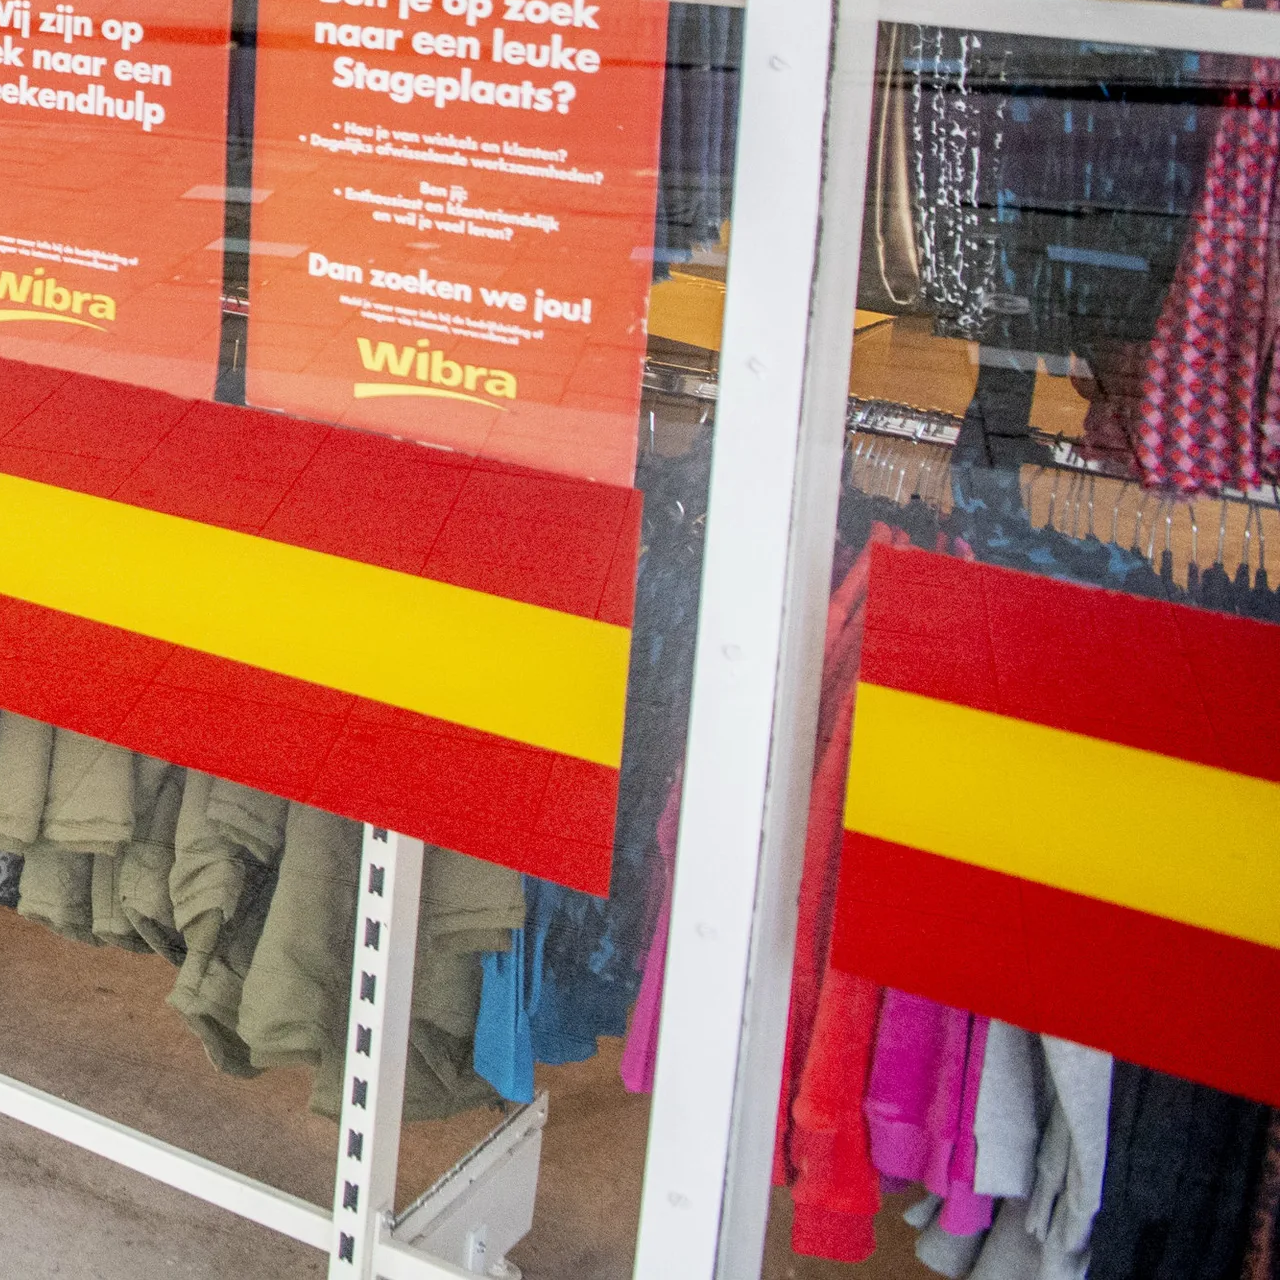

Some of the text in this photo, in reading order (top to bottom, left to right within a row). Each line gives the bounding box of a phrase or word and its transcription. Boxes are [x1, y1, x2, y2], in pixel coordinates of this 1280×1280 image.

[39, 4, 93, 44] zijn
[101, 19, 144, 51] op
[314, 21, 601, 74] naar een leuke
[32, 48, 107, 77] naar
[114, 58, 172, 86] een
[332, 56, 576, 115] Stageplaats?
[310, 133, 604, 185] Dagelijks afwisselende werkzaamheden?
[344, 121, 568, 163] Hou je van winkels en klanten?
[345, 187, 559, 233] Enthousiast en klantvriendelijk
[419, 181, 447, 198] Ben
[372, 210, 391, 222] en
[393, 211, 416, 227] wil
[418, 214, 432, 231] je
[435, 219, 465, 234] veel
[308, 252, 592, 324] Dan zoeken we jou!
[357, 337, 517, 400] Wibra
